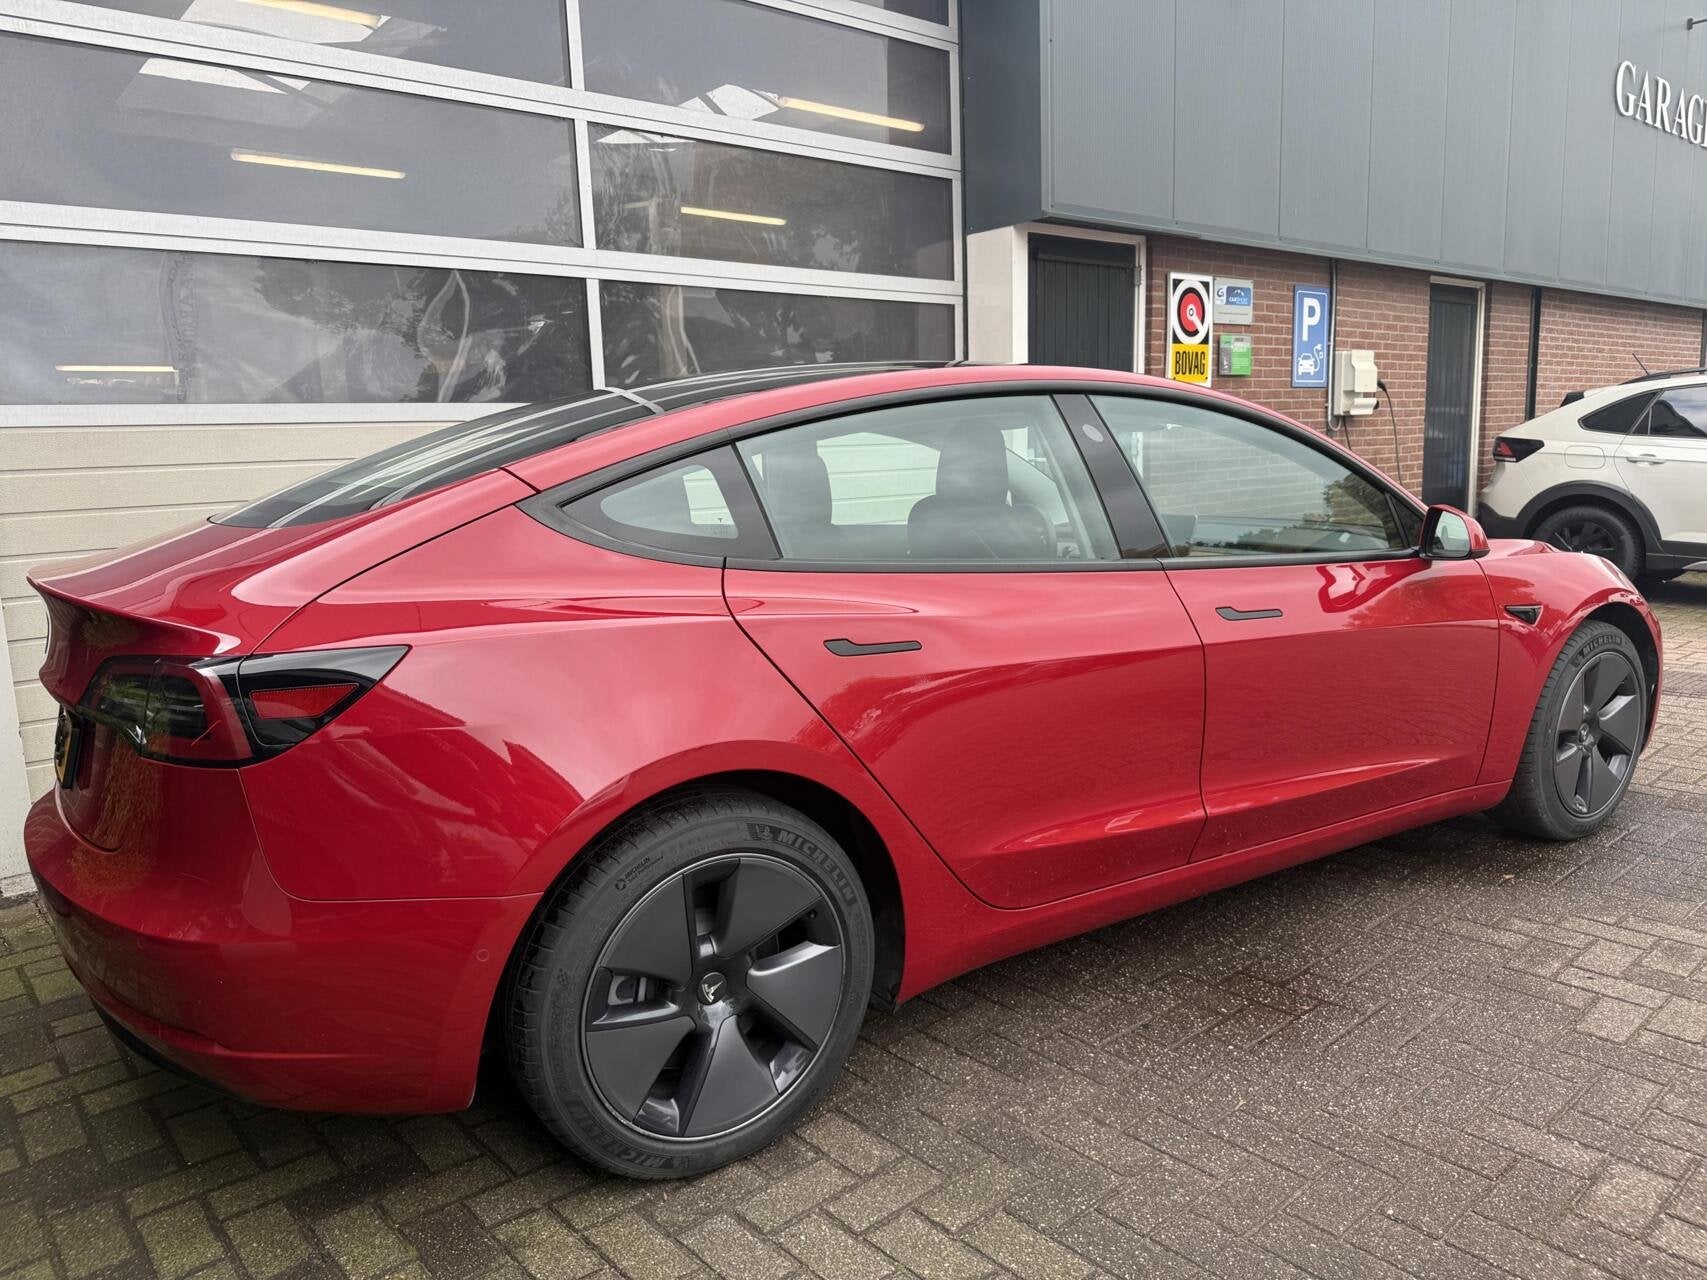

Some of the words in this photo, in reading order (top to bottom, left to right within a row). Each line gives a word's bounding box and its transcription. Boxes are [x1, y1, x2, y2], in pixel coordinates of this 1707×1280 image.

[1302, 297, 1321, 341] P
[1175, 350, 1206, 376] BOVAG
[1582, 634, 1621, 657] MICHELIN
[778, 829, 855, 903] MICHELIN
